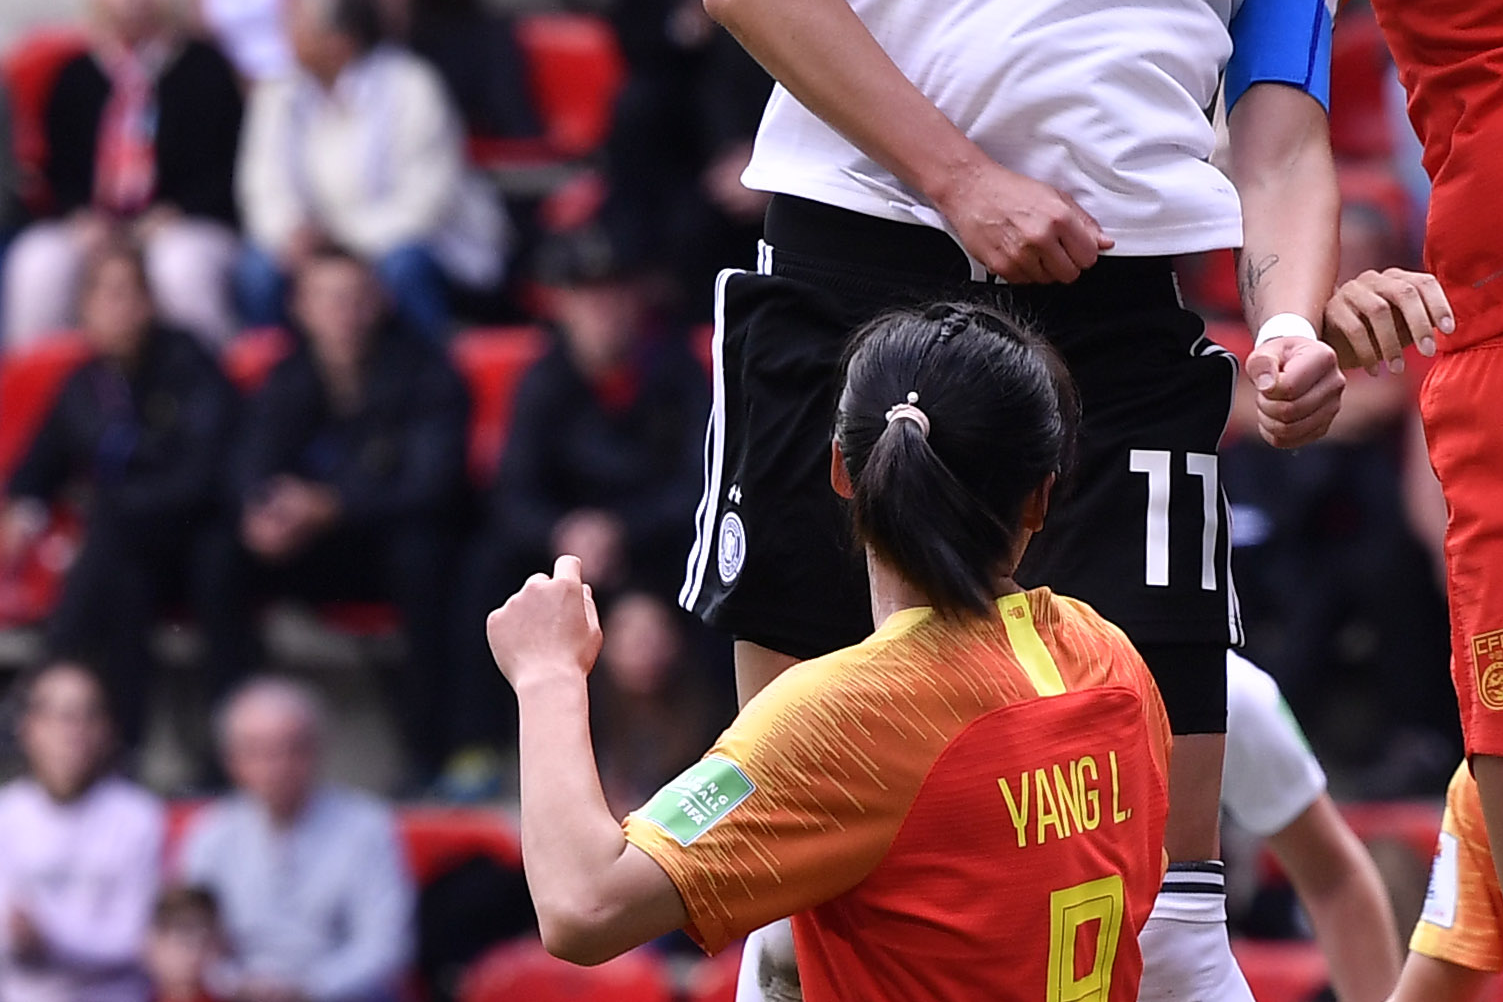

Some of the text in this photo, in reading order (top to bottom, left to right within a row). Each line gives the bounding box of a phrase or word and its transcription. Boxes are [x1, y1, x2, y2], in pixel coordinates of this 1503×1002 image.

[1129, 449, 1218, 591] 11
[676, 797, 708, 827] FIFA
[997, 750, 1133, 848] YANG L.
